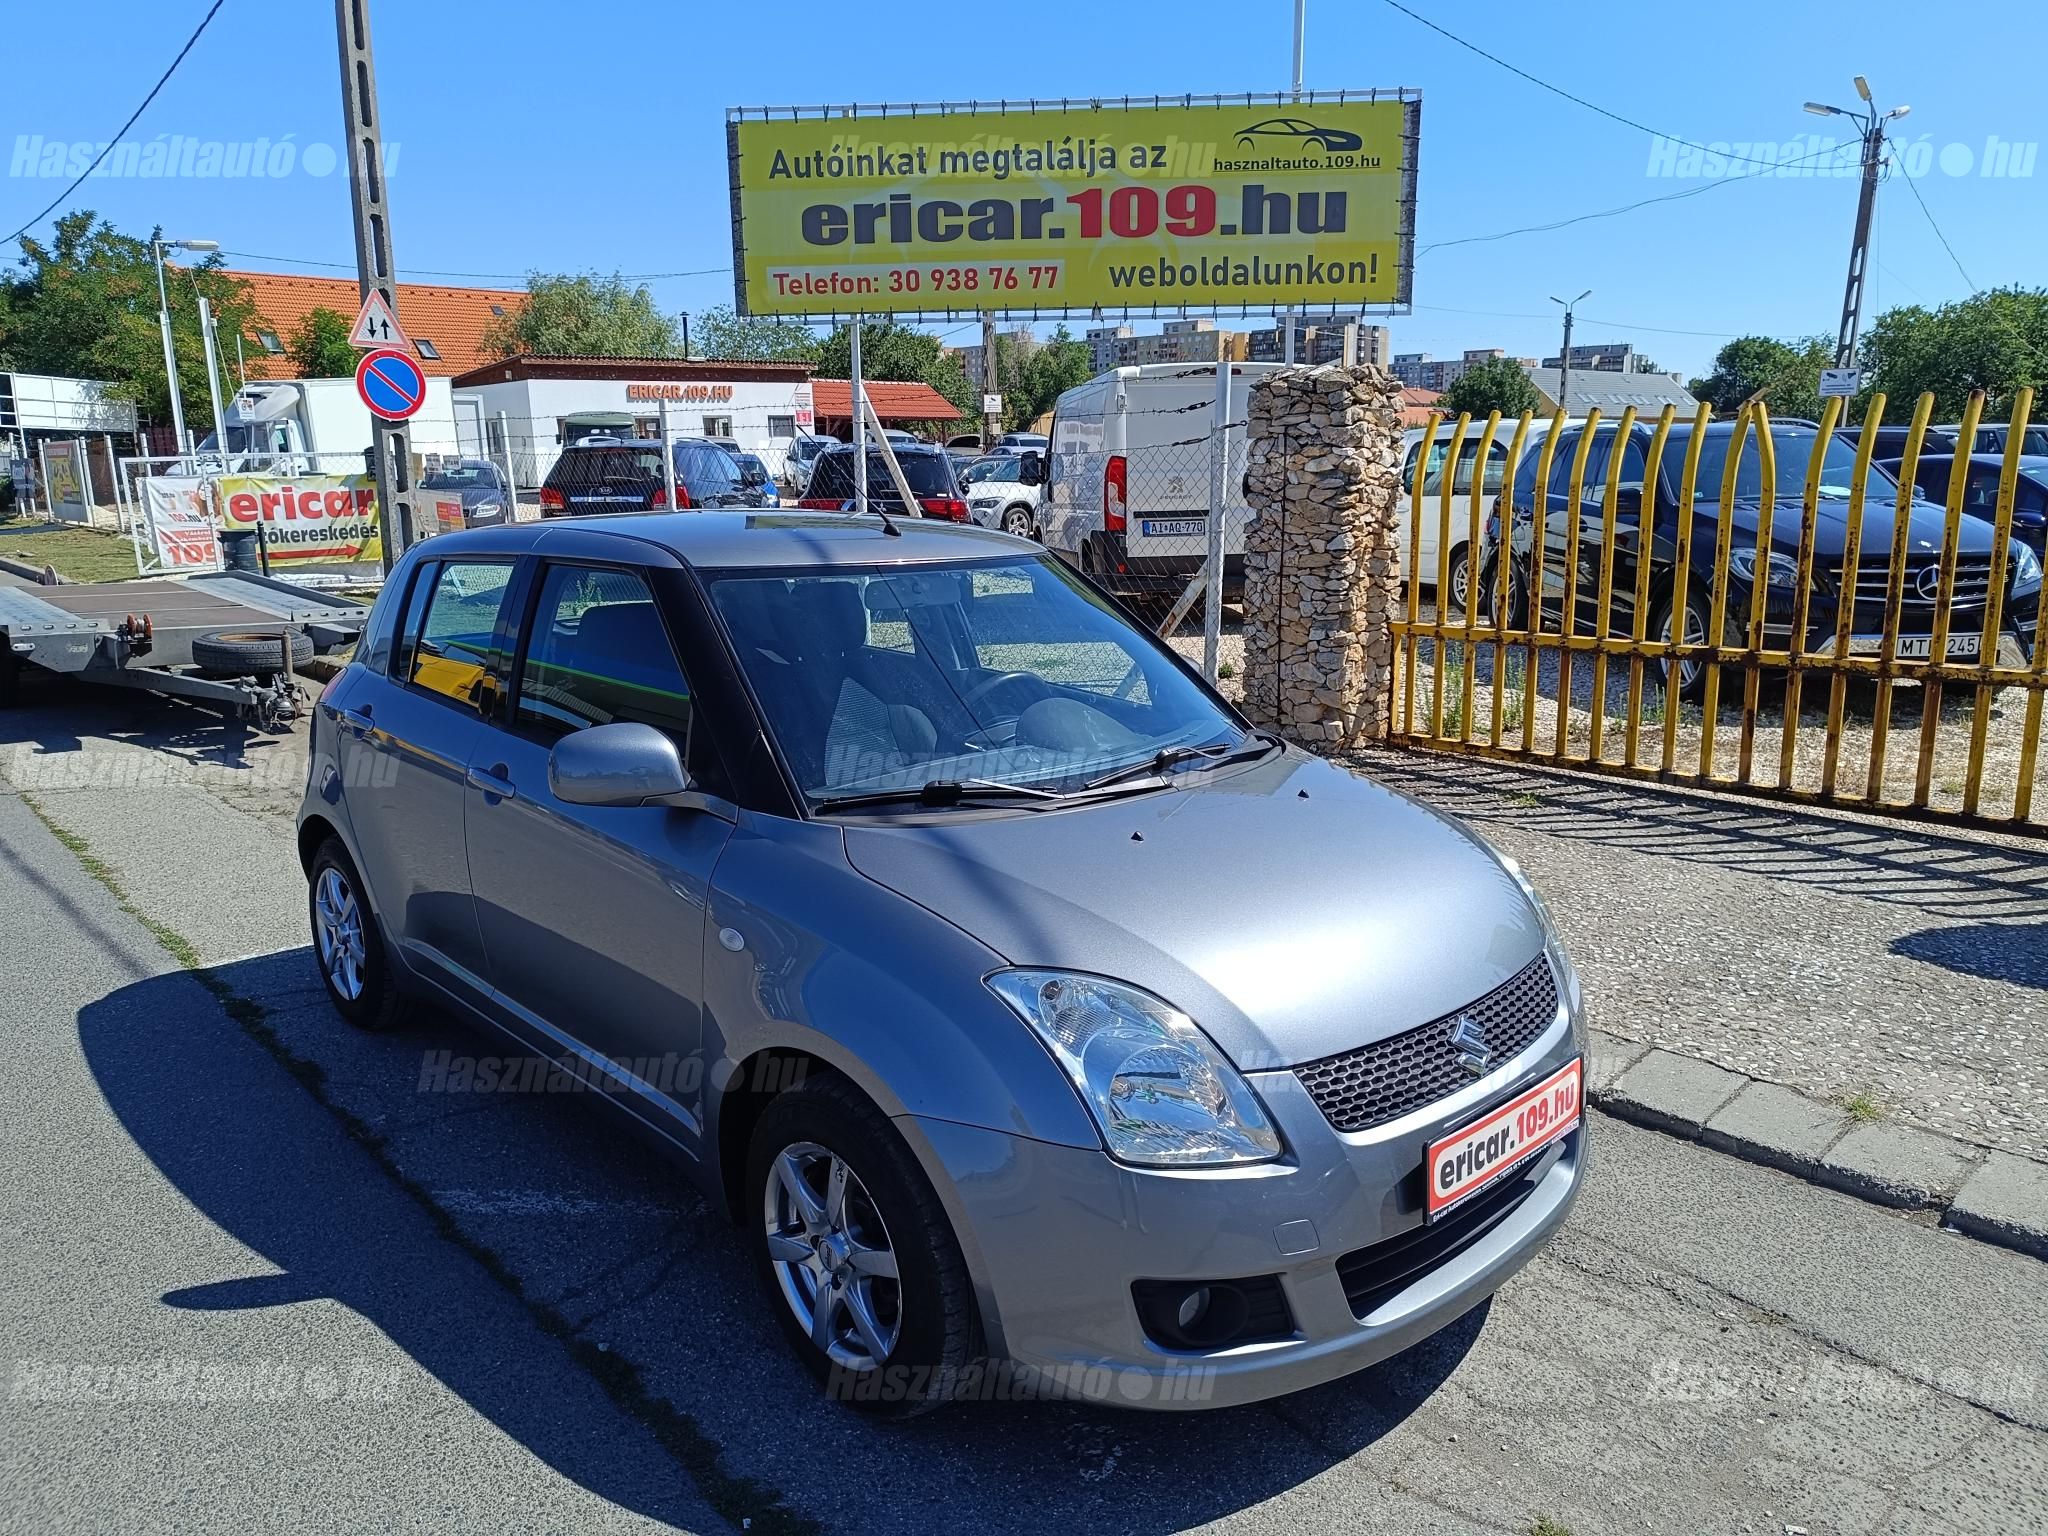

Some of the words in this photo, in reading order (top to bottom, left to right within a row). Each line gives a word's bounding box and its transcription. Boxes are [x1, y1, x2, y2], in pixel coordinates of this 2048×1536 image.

[768, 144, 927, 180] Autóinkat
[939, 137, 1117, 180] megtalálja
[1129, 145, 1167, 170] az
[1213, 156, 1382, 172] hasznaltauto.109.hu
[801, 183, 1347, 247] ericar.109.hu
[773, 271, 881, 296] Telefon:
[889, 270, 922, 292] 30
[930, 269, 980, 292] 938
[990, 267, 1020, 290] 76
[1027, 266, 1060, 290] 77
[1109, 253, 1378, 289] weboldalunkon!
[229, 486, 375, 523] ericar
[265, 522, 379, 545] ókereskedés
[1440, 1082, 1575, 1189] ericar.109.hu
